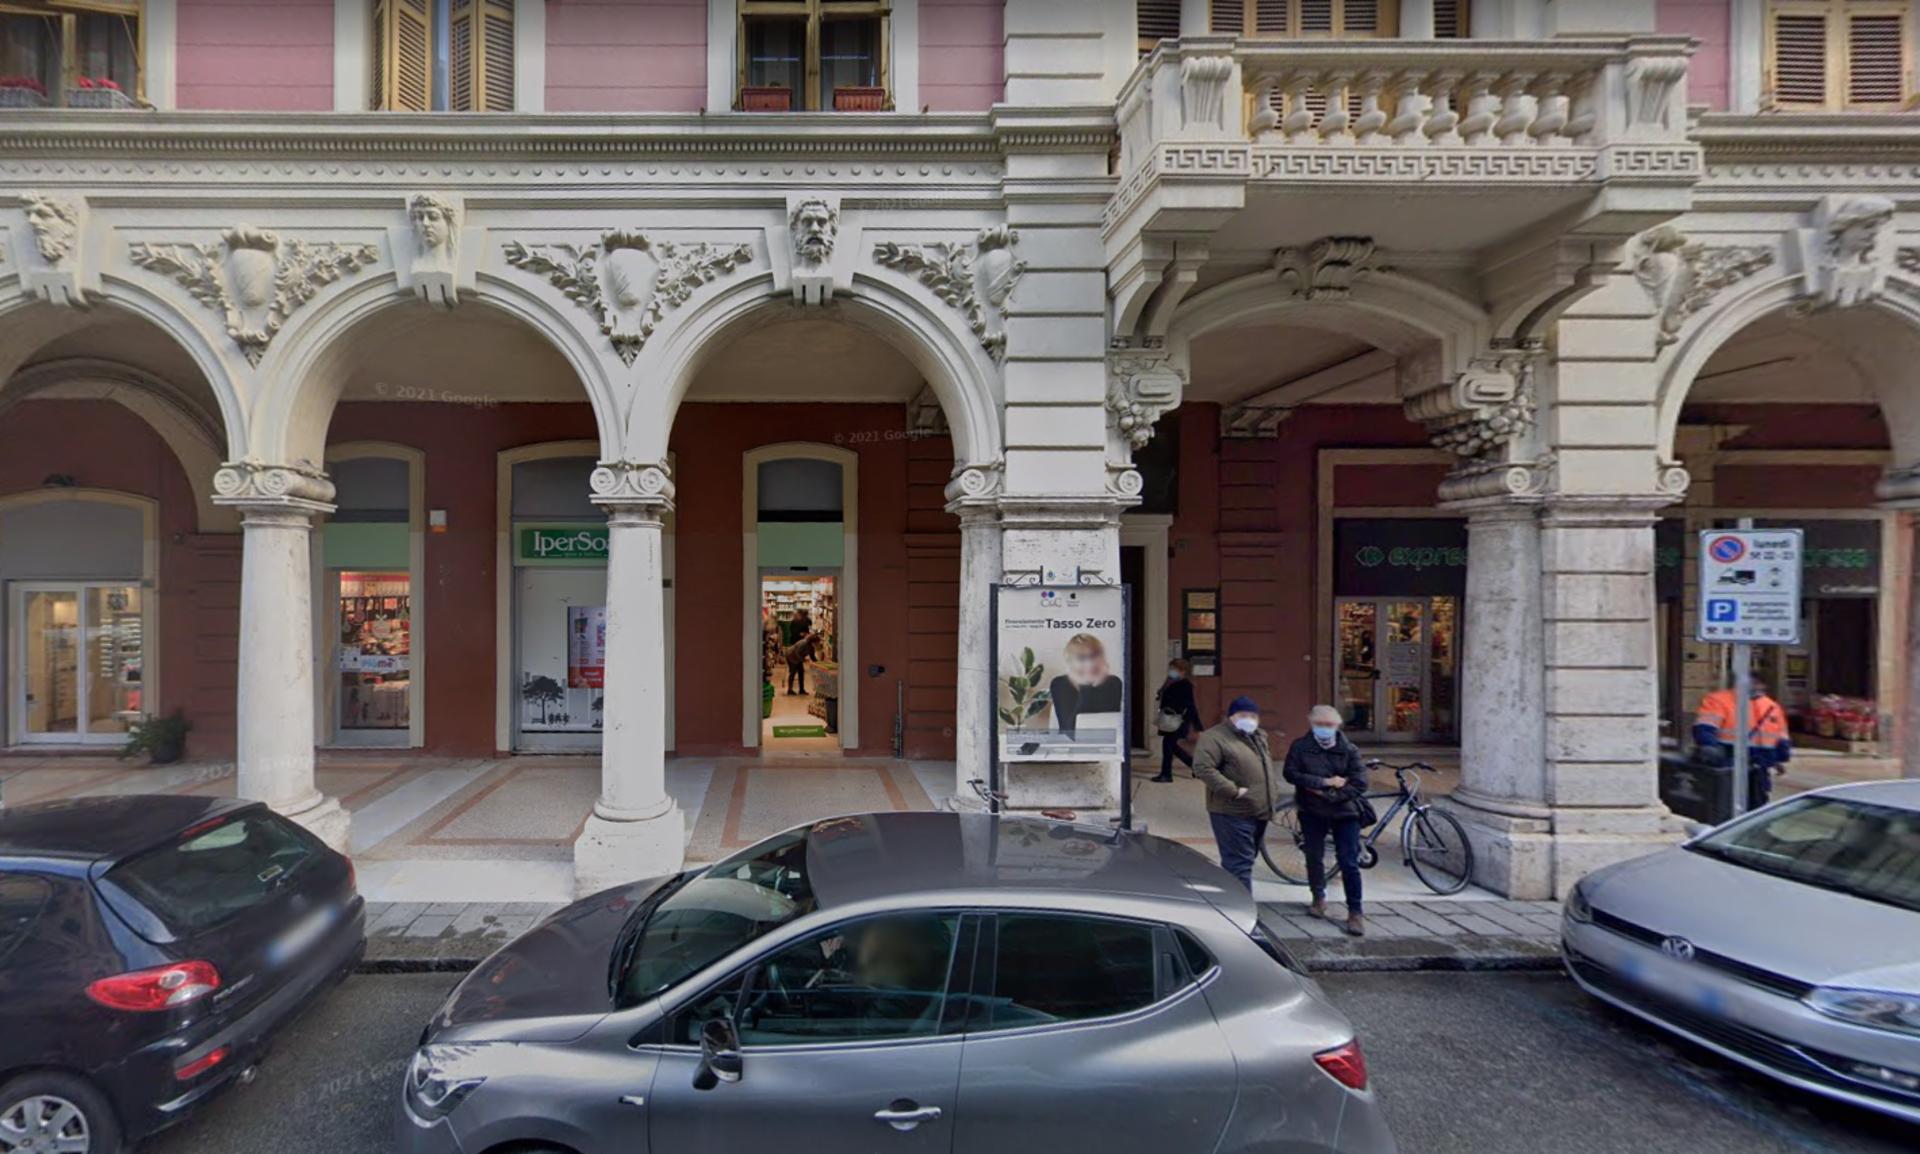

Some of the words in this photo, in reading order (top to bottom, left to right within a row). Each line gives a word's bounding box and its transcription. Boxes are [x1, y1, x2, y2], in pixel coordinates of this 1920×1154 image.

[533, 530, 609, 557] IperSo
[1046, 618, 1083, 629] Tasso
[1086, 618, 1116, 629] Zero
